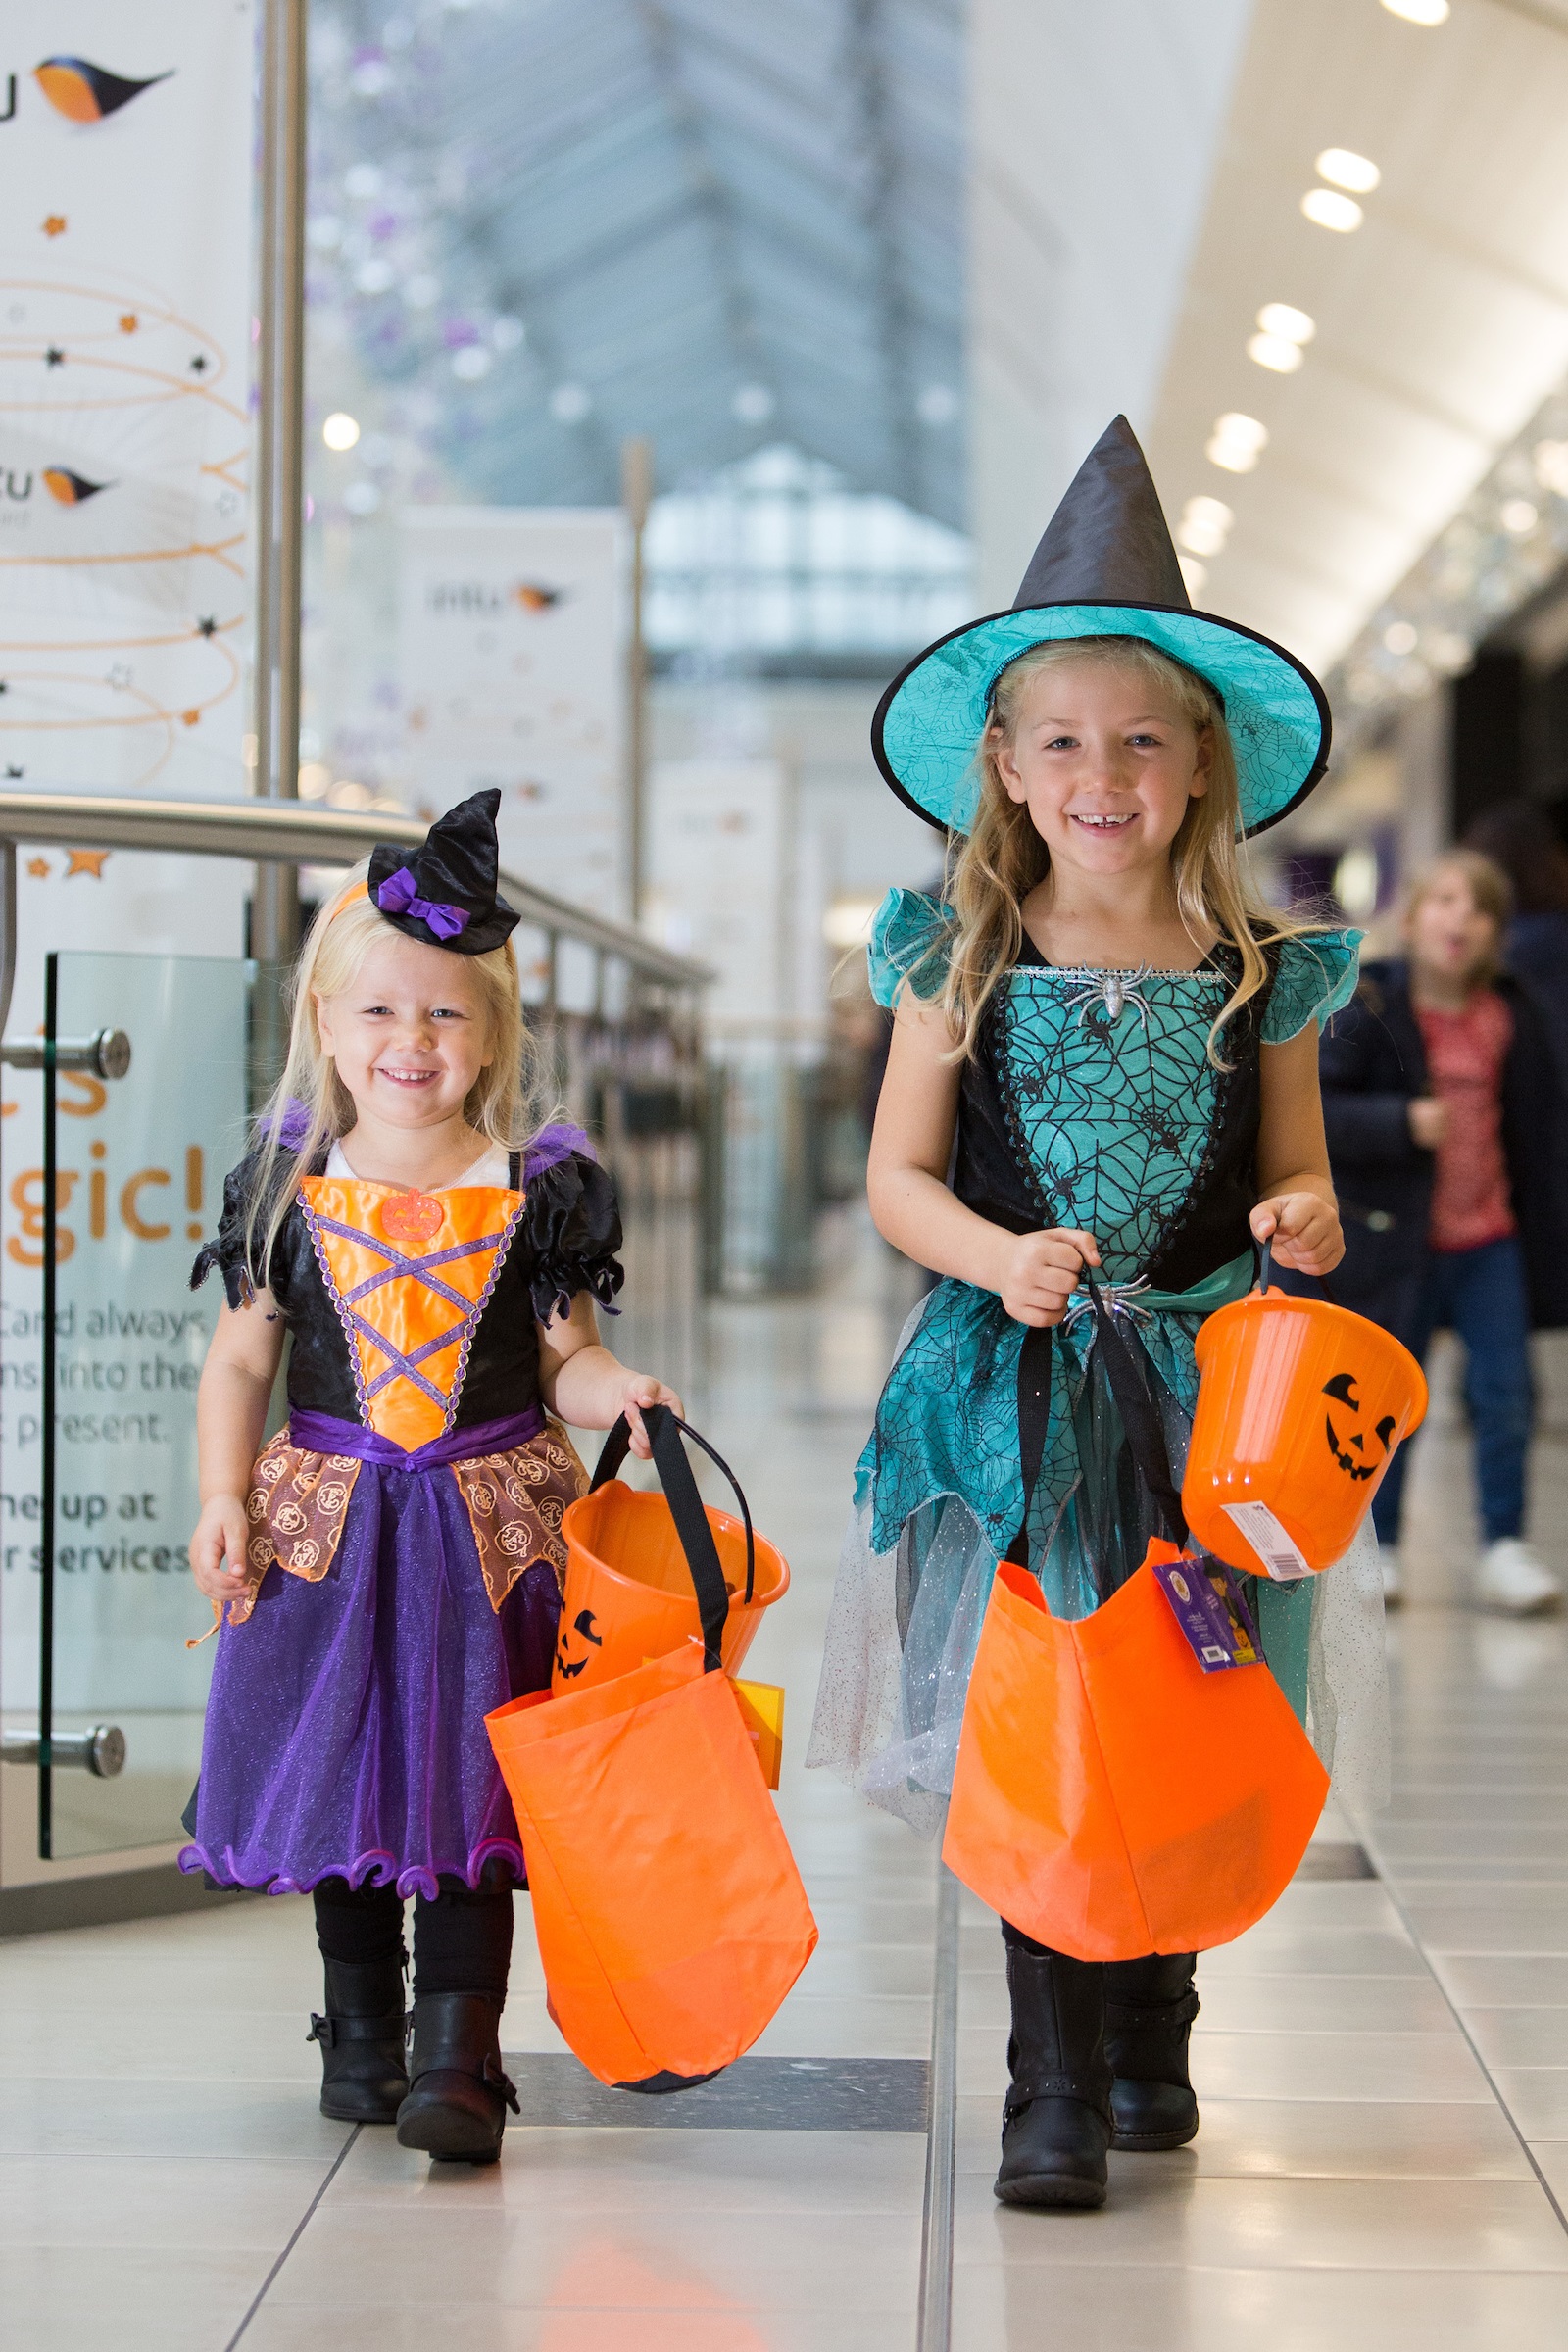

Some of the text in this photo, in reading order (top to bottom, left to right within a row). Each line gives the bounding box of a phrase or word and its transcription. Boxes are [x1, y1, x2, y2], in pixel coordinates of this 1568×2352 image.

[6, 1138, 204, 1267] gic!
[86, 1299, 208, 1346] always
[59, 1354, 126, 1391] into
[139, 1354, 201, 1390] the
[62, 1494, 108, 1528] up
[118, 1494, 156, 1520] at
[30, 1538, 190, 1573] services
